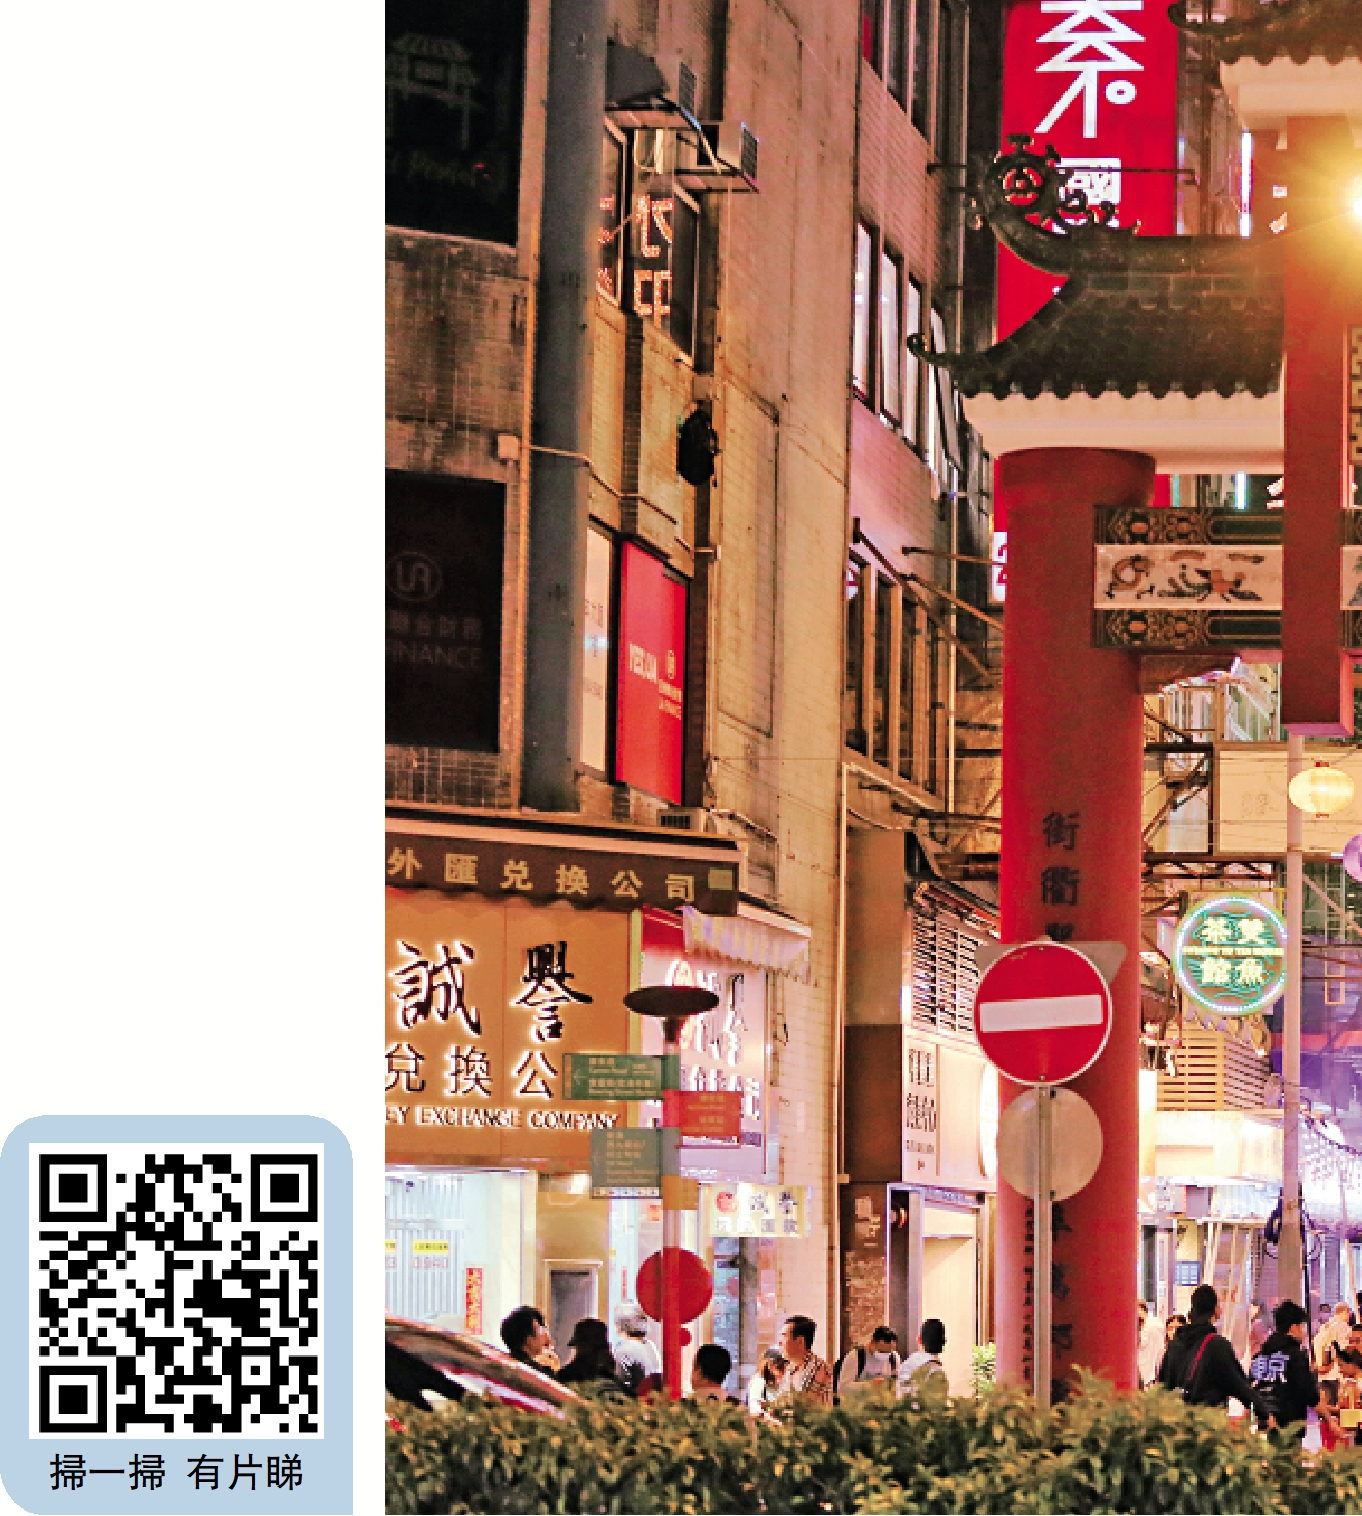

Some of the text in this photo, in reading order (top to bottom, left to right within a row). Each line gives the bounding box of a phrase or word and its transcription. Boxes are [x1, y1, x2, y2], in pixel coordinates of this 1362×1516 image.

[388, 846, 695, 902] 外匯兌換公司
[417, 1106, 522, 1128] EXCHANGE
[527, 1109, 619, 1130] COMPANY
